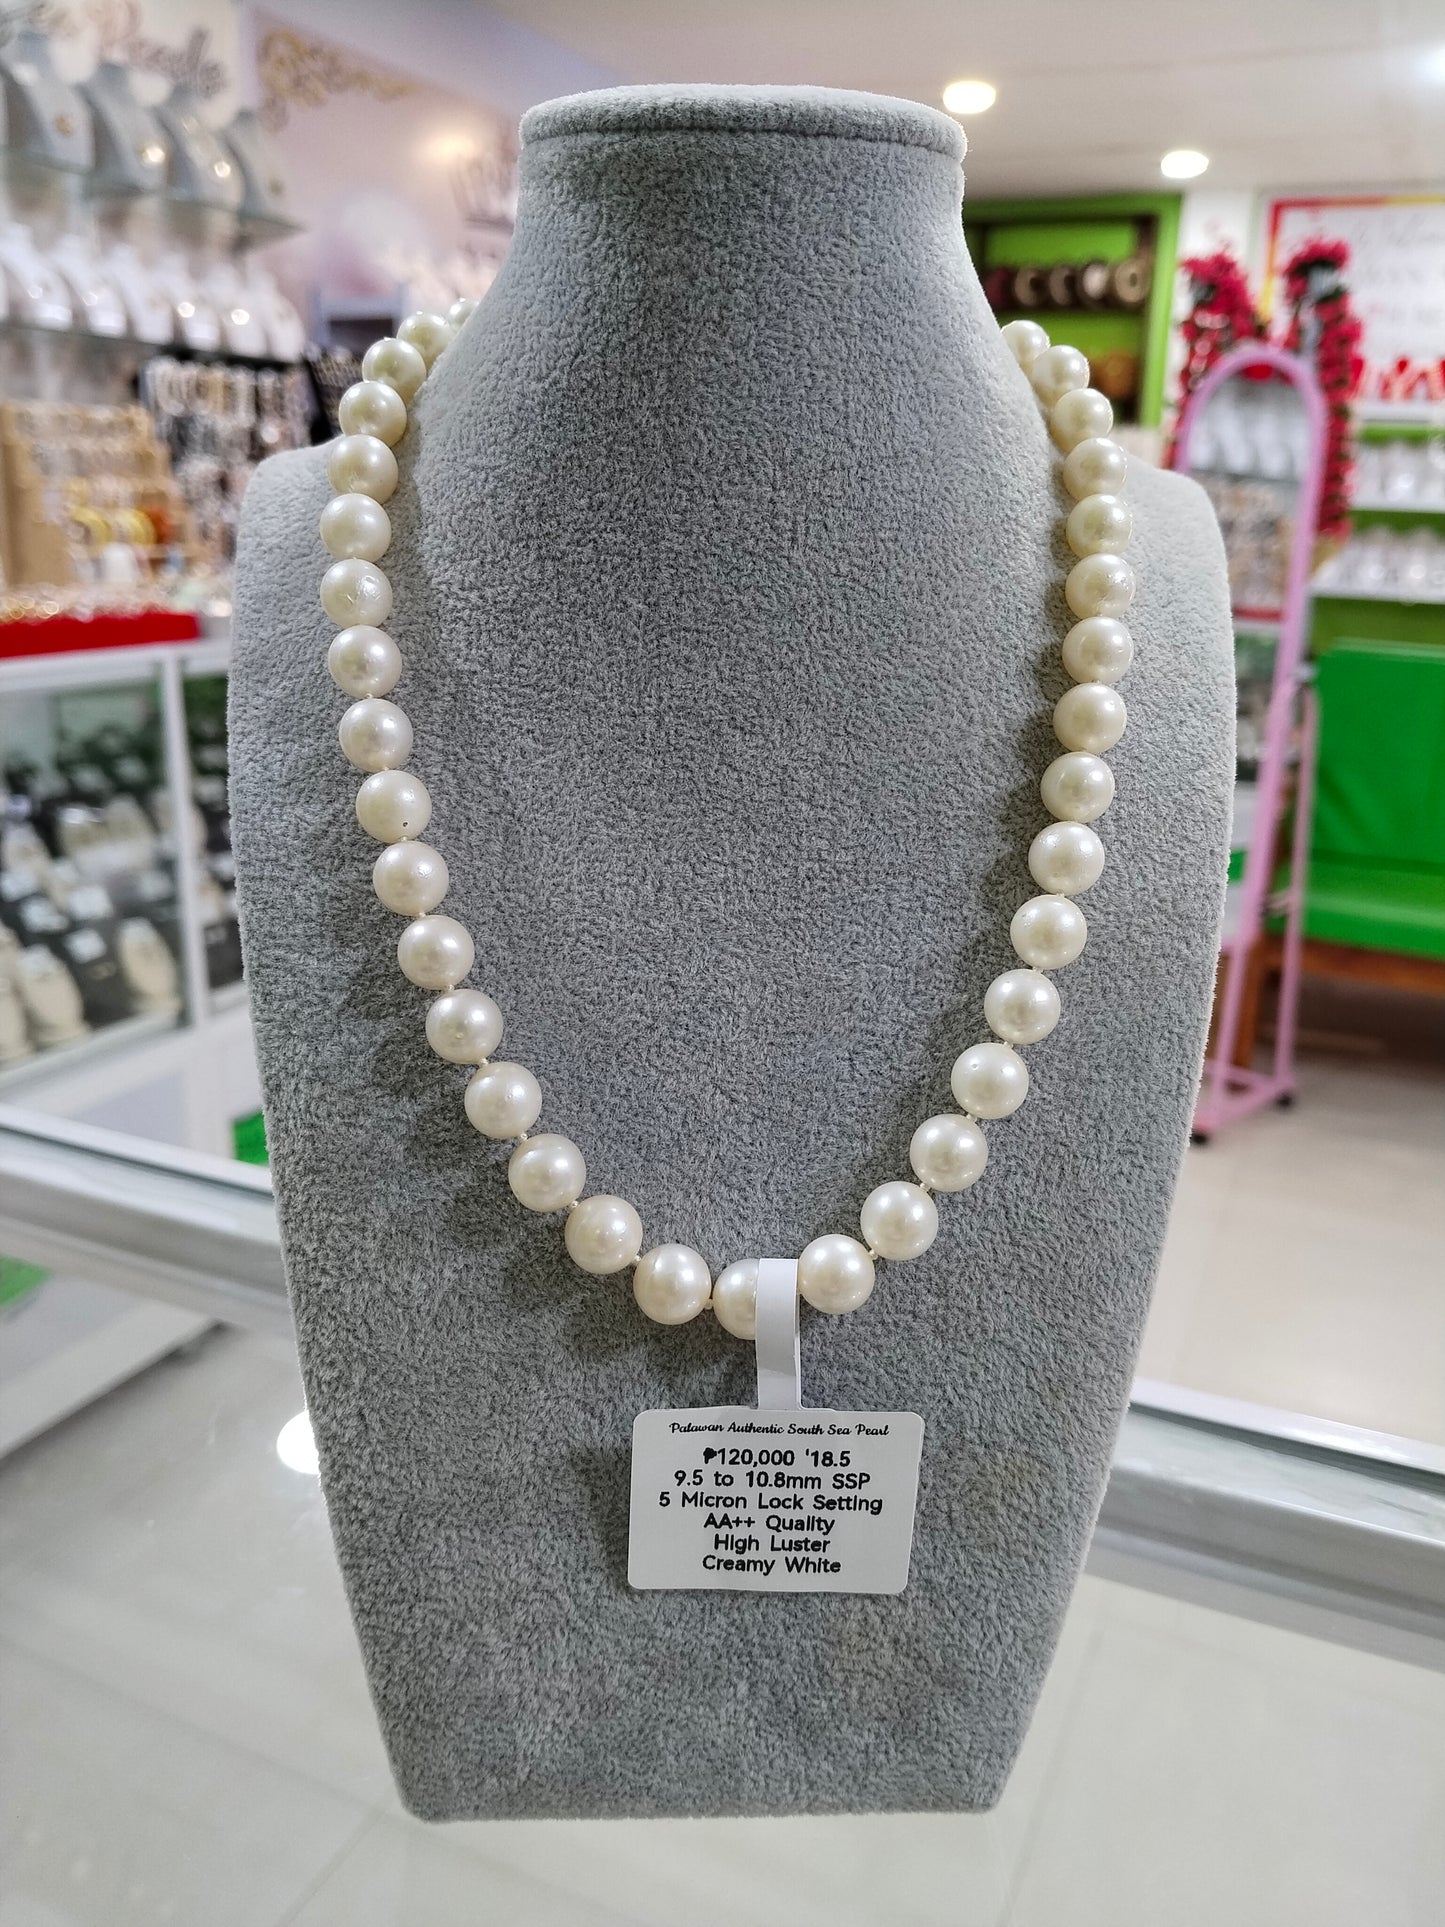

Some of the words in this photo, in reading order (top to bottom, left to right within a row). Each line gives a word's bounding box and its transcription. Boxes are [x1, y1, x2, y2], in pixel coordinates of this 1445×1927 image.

[669, 1422, 725, 1433] Palawan
[727, 1421, 785, 1434] Authentic
[787, 1423, 825, 1435] South
[827, 1424, 852, 1435] Sea
[855, 1424, 889, 1435] Pearl
[674, 1469, 703, 1486] 9.5
[714, 1471, 734, 1487] to
[746, 1470, 821, 1489] 10.8mm
[832, 1473, 870, 1490] SSP
[659, 1491, 670, 1507] 5
[682, 1491, 747, 1509] Micron
[758, 1492, 804, 1510] Lock
[813, 1494, 882, 1516] Setting
[704, 1512, 755, 1529] AA++
[766, 1514, 835, 1536] Quality
[714, 1533, 759, 1555] High
[771, 1535, 831, 1553] Luster
[702, 1554, 776, 1576] Creamy
[785, 1556, 841, 1573] White
